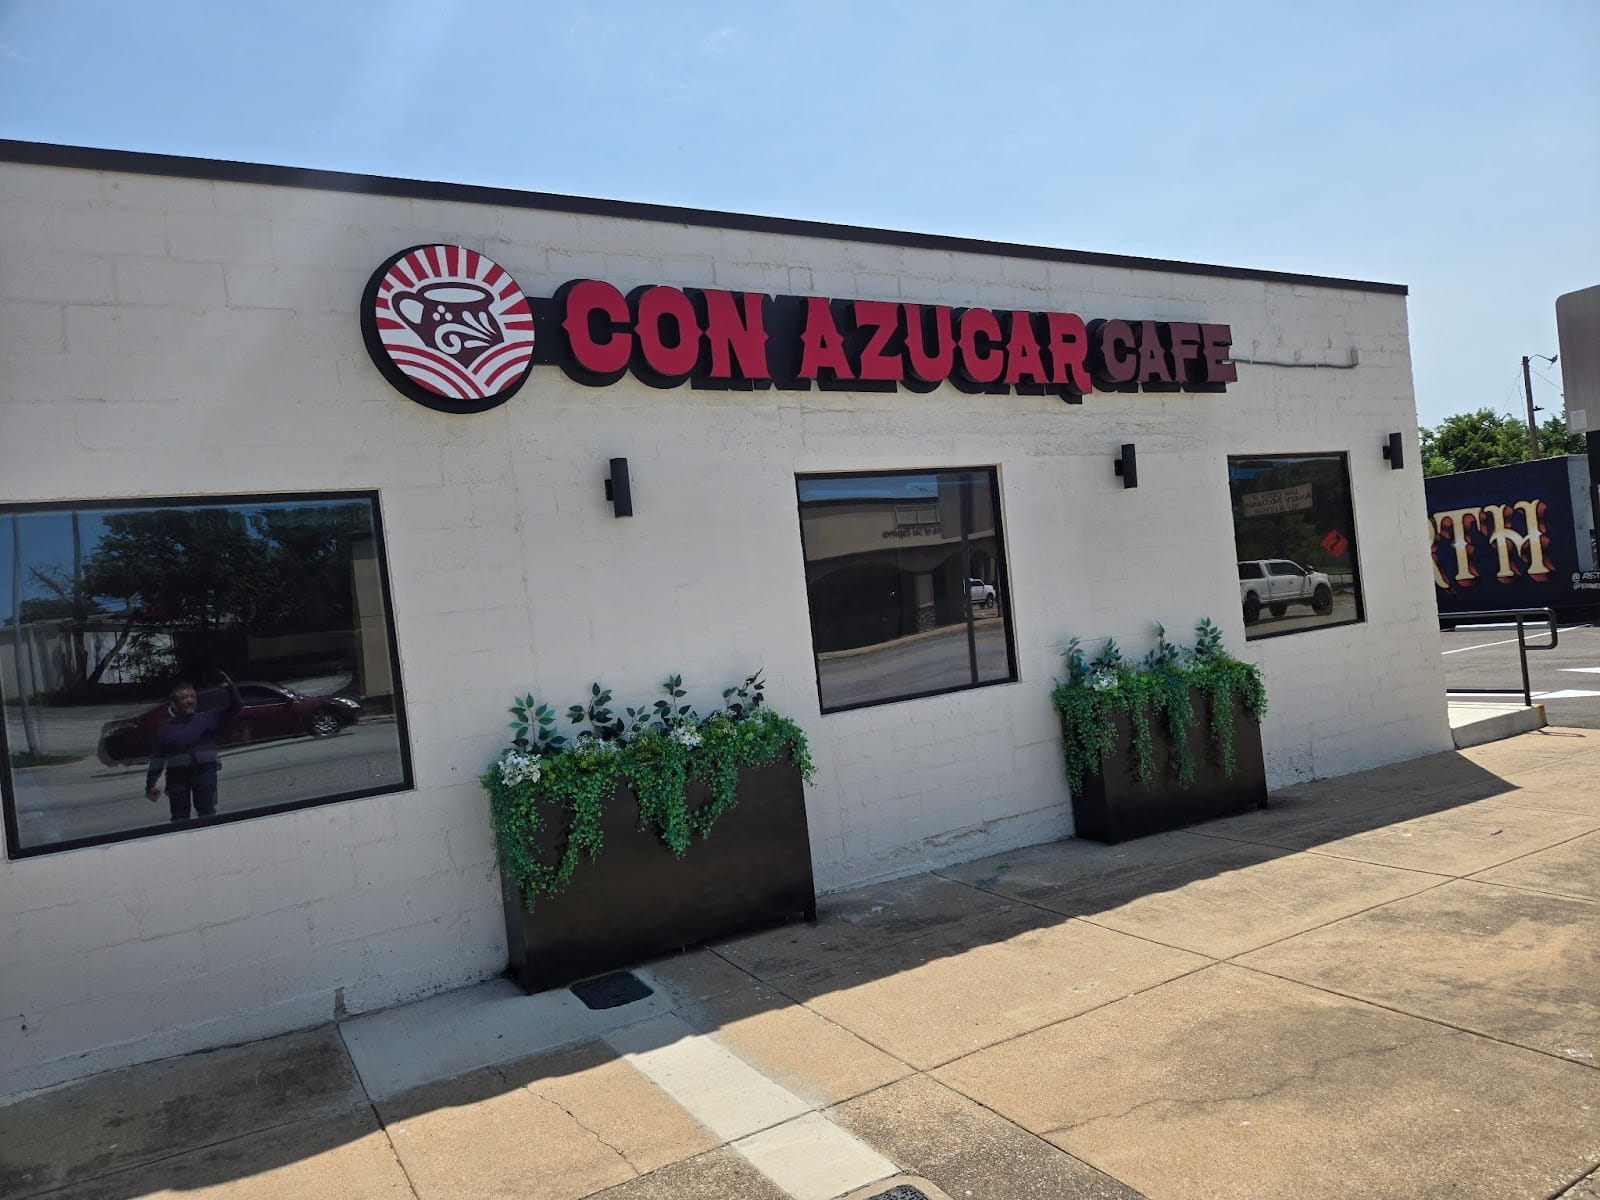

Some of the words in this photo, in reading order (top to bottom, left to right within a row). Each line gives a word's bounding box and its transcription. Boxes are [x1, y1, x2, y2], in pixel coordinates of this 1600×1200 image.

[561, 279, 770, 378] CON
[798, 296, 1093, 395] AZUCAR
[1100, 319, 1238, 383] CAFE
